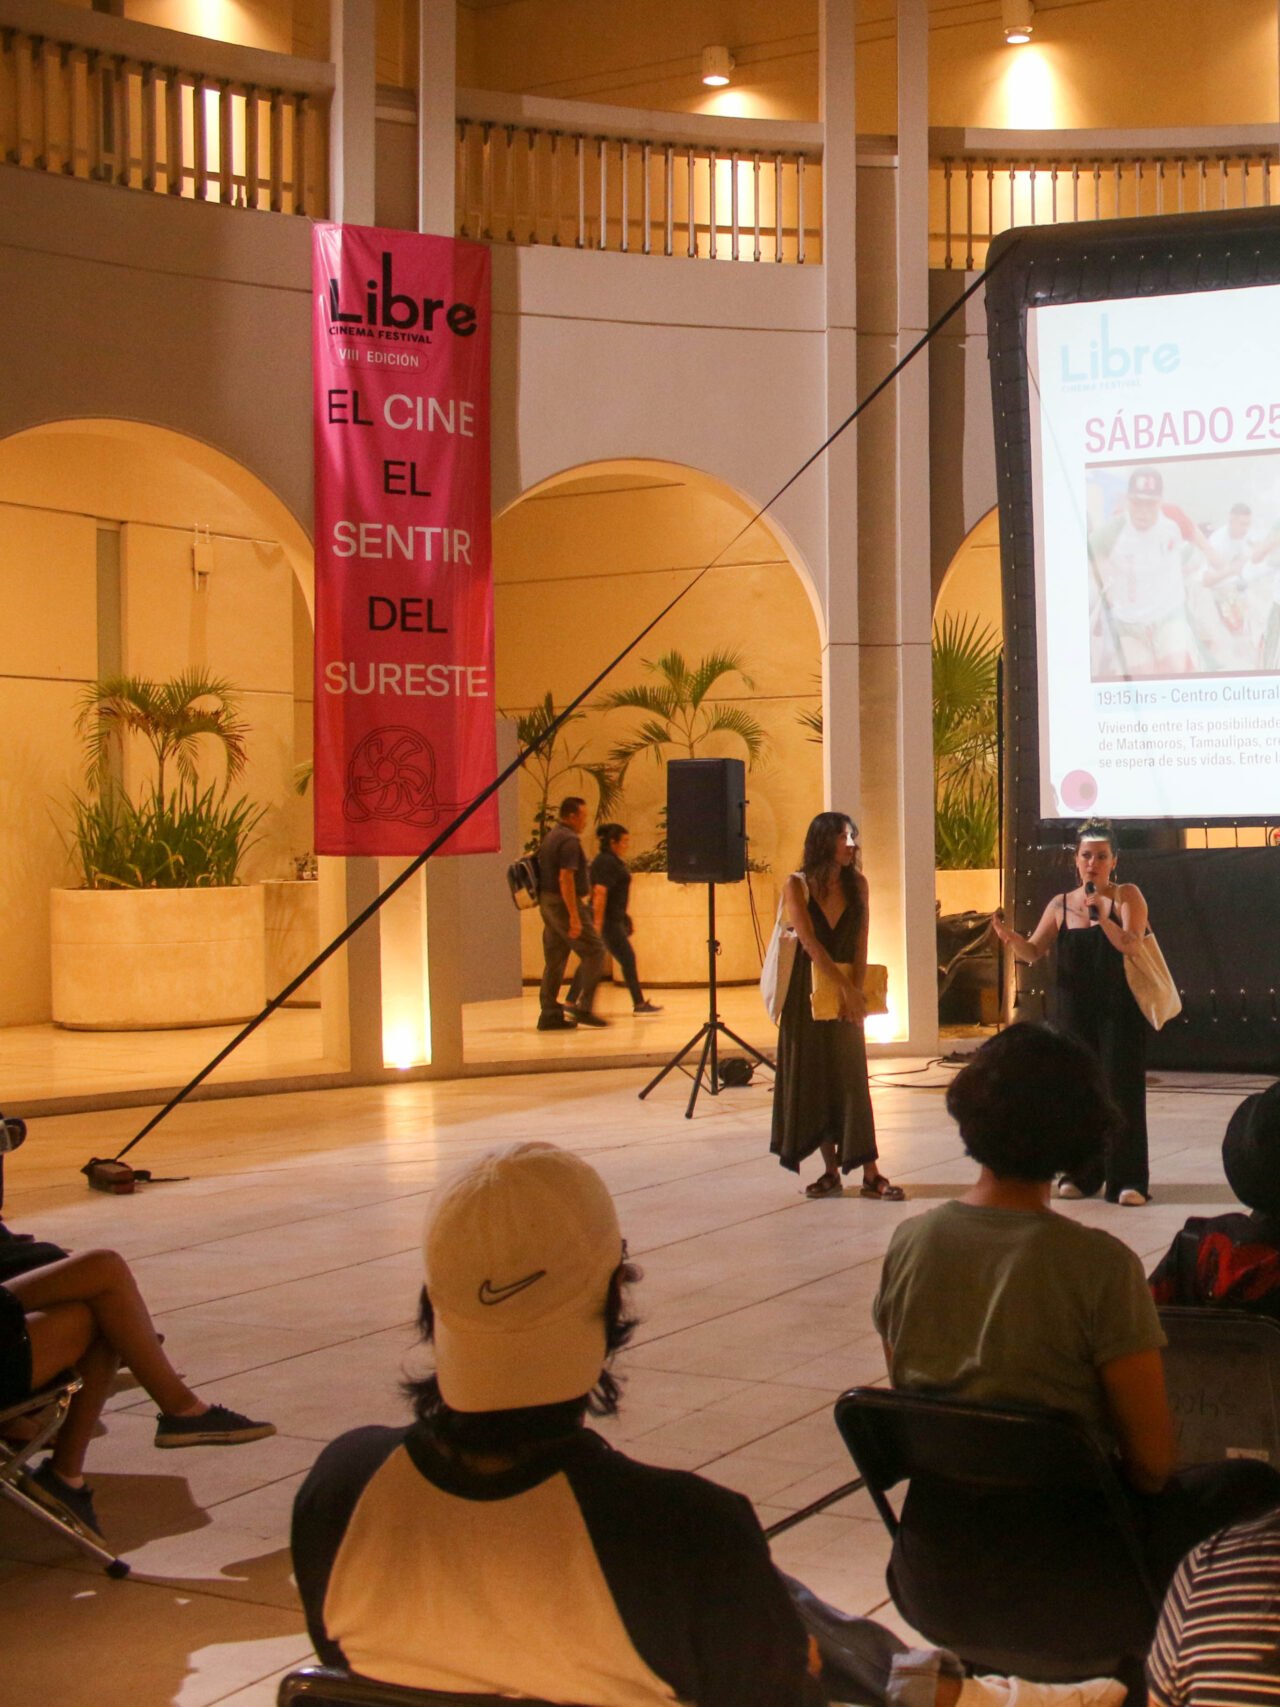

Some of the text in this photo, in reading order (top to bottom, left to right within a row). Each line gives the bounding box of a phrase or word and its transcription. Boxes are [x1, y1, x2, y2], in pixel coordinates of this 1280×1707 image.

[329, 251, 477, 338] Libre
[329, 326, 432, 344] CINEMA FESTIVAL
[1060, 313, 1182, 382] Libre
[338, 348, 359, 361] VIII
[328, 389, 474, 437] EL CINE
[1085, 406, 1234, 453] SÁBADO
[383, 460, 432, 497] EL
[332, 521, 471, 565] SENTIR
[368, 596, 448, 633] DEL
[324, 661, 489, 697] SURESTE
[1098, 690, 1132, 706] 19:15
[1135, 688, 1157, 705] hrs
[1170, 687, 1218, 703] Centro
[1222, 684, 1280, 702] Cultural
[1098, 720, 1149, 734] Viviendo
[1151, 721, 1183, 733] entre
[1186, 719, 1203, 732] las
[1099, 738, 1113, 751] de
[1116, 737, 1186, 752] Matamoros,
[1190, 734, 1262, 750] Tamaulipas,
[1099, 757, 1112, 769] se
[1115, 756, 1155, 770] espera
[1158, 754, 1173, 767] de
[1176, 755, 1197, 767] sus
[1200, 753, 1236, 766] vidas.
[1239, 751, 1272, 765] Entre
